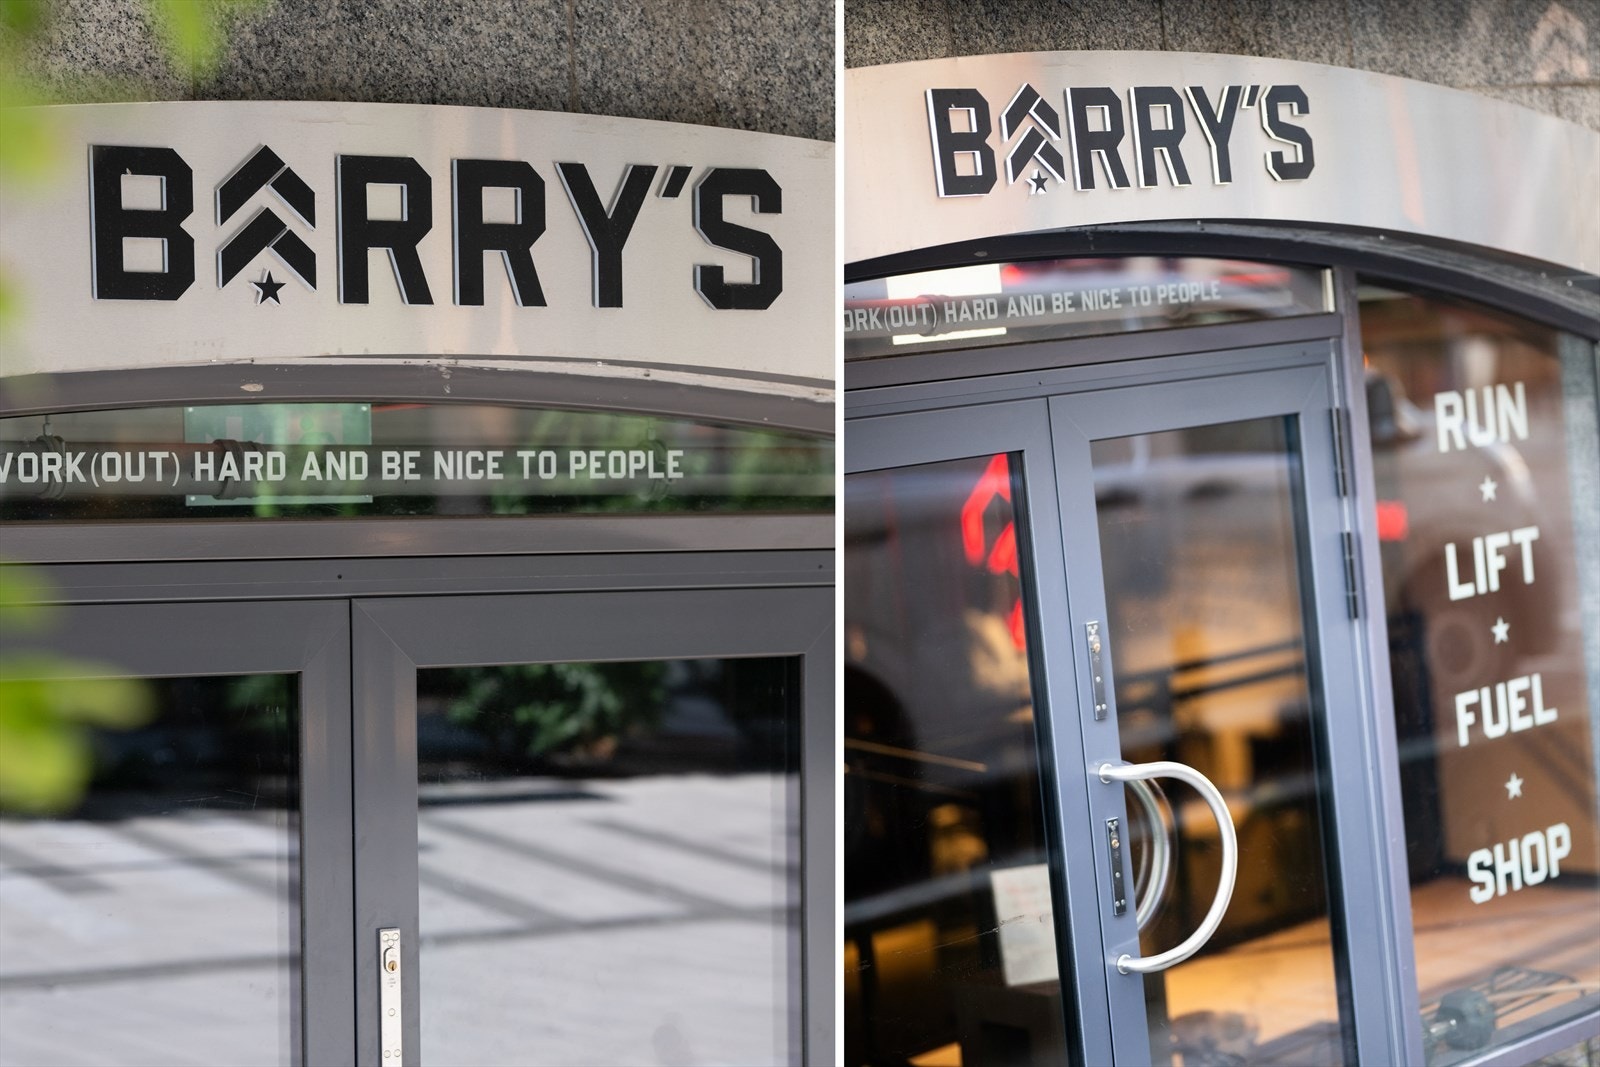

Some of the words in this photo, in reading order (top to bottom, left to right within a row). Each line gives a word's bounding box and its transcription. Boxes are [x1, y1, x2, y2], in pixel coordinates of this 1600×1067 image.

[944, 297, 998, 324] HARD
[1006, 293, 1046, 318] AND
[1052, 292, 1076, 315] BE
[1081, 288, 1122, 312] NICE
[1128, 285, 1151, 308] TO
[1156, 280, 1222, 305] PEOPLE
[1434, 381, 1530, 453] RUN
[194, 451, 286, 481] HARD
[300, 450, 369, 481] AND
[381, 450, 421, 481] BE
[434, 450, 504, 480] NICE
[517, 450, 557, 480] TO
[569, 449, 684, 480] PEOPLE
[1445, 525, 1540, 601] LIFT
[1455, 673, 1558, 748] FUEL
[1467, 822, 1572, 905] SHOP
